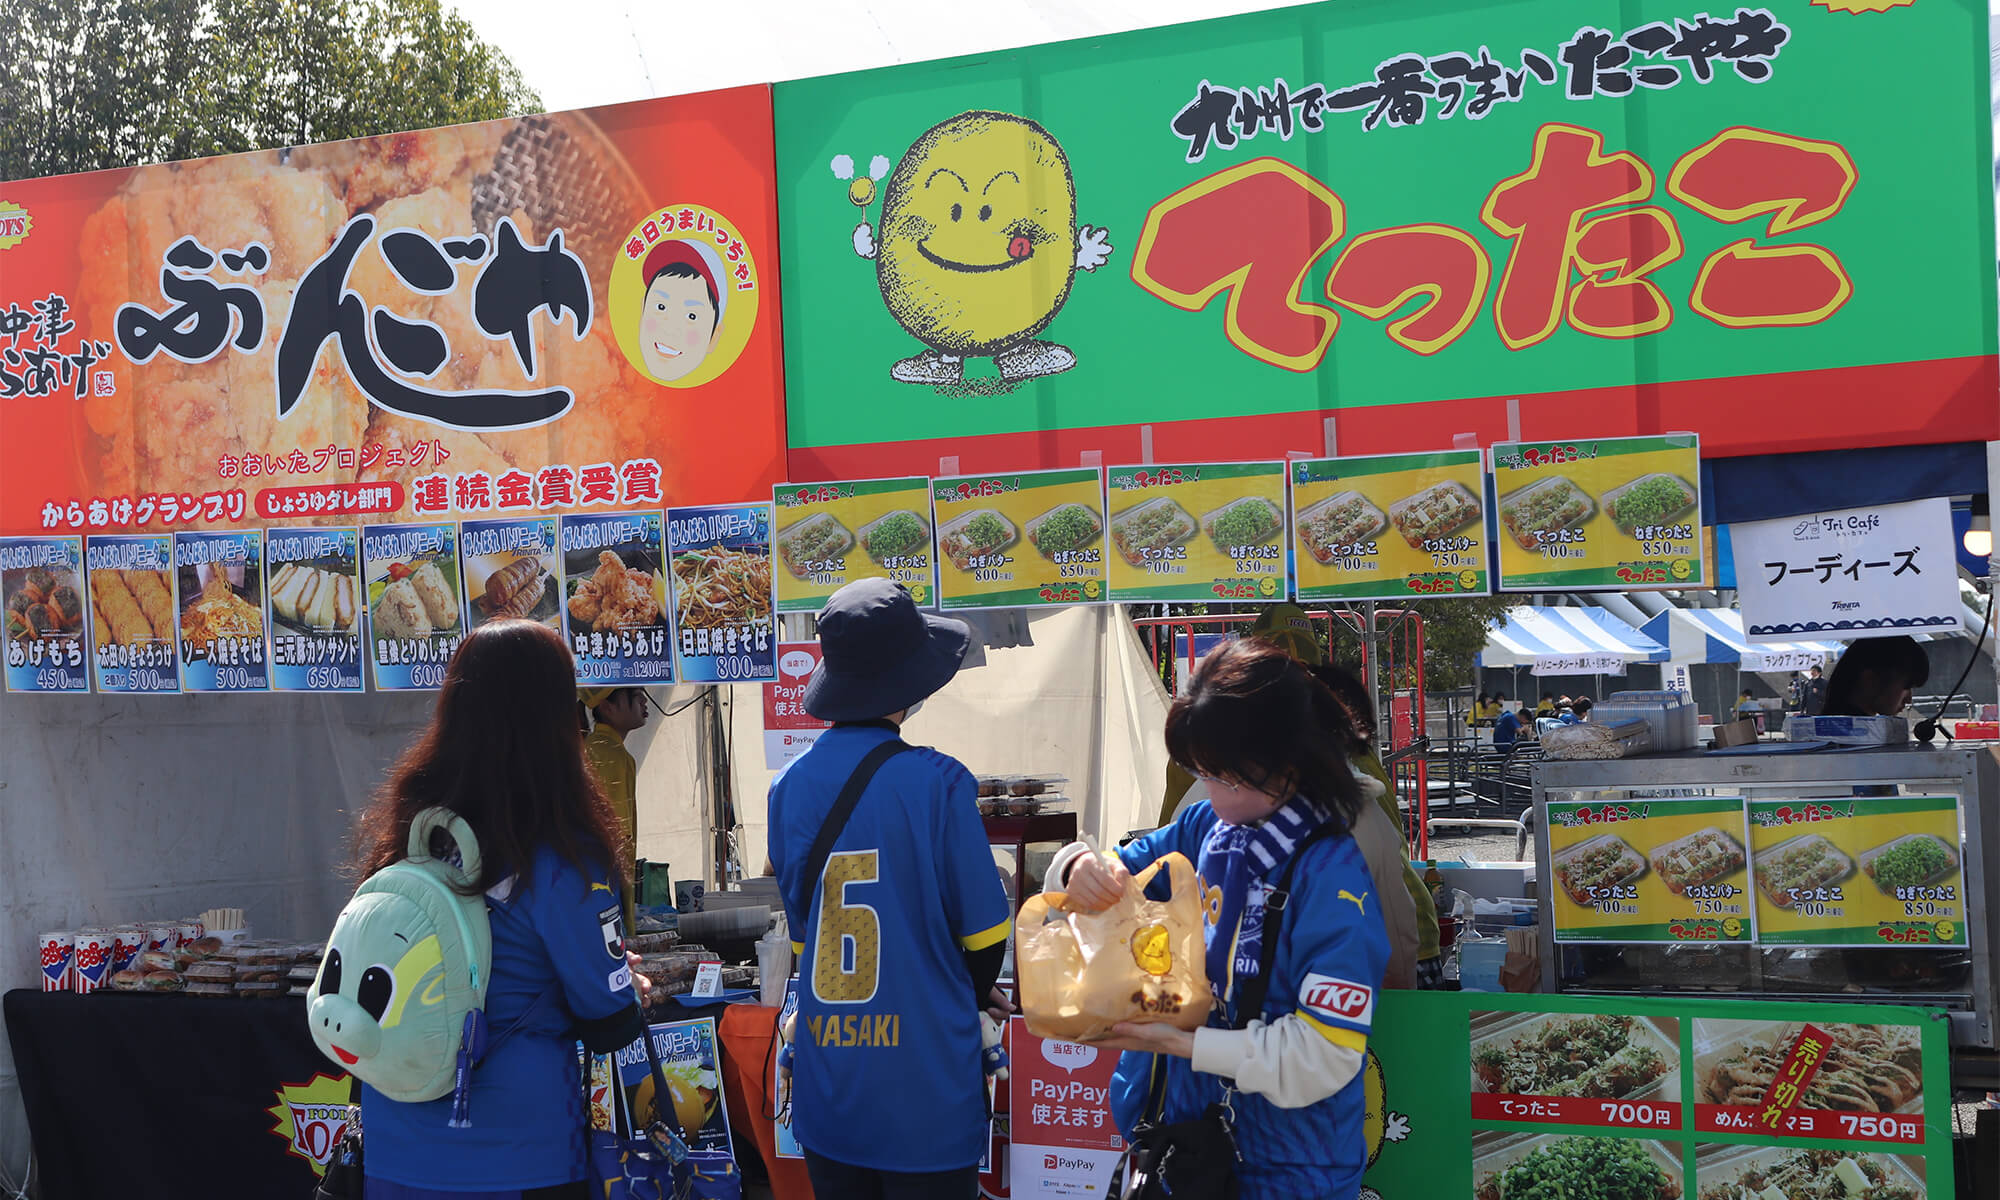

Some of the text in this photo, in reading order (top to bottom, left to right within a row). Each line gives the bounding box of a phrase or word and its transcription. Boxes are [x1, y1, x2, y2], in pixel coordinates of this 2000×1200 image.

[1172, 7, 1790, 163] 九州で一番うまい たこやき
[1131, 122, 1858, 373] てったこ
[114, 213, 594, 432] ぶんごや
[218, 439, 451, 478] おおいたプロジェクト
[265, 486, 393, 514] しょうゆダレ部門
[413, 458, 663, 515] 連続金賞受賞
[41, 491, 246, 528] からあげグランプリ
[1823, 514, 1880, 531] Tri Café
[1764, 546, 1921, 586] フーディーズ
[9, 639, 83, 668] あげもち
[182, 637, 264, 667] ソース焼きそば
[574, 630, 666, 660] 中津からあげ
[681, 626, 769, 657] 日田焼きそば
[811, 848, 882, 1005] 6
[1309, 981, 1368, 1020] TKP
[806, 1014, 899, 1047] MASAKI
[1031, 1079, 1108, 1105] PayPay
[1761, 1036, 1824, 1130] 売り切れ
[1031, 1103, 1108, 1128] 使えます
[1499, 1099, 1672, 1126] てったこ 700円
[1840, 1115, 1917, 1139] 750円
[1059, 1157, 1096, 1172] PayPay
